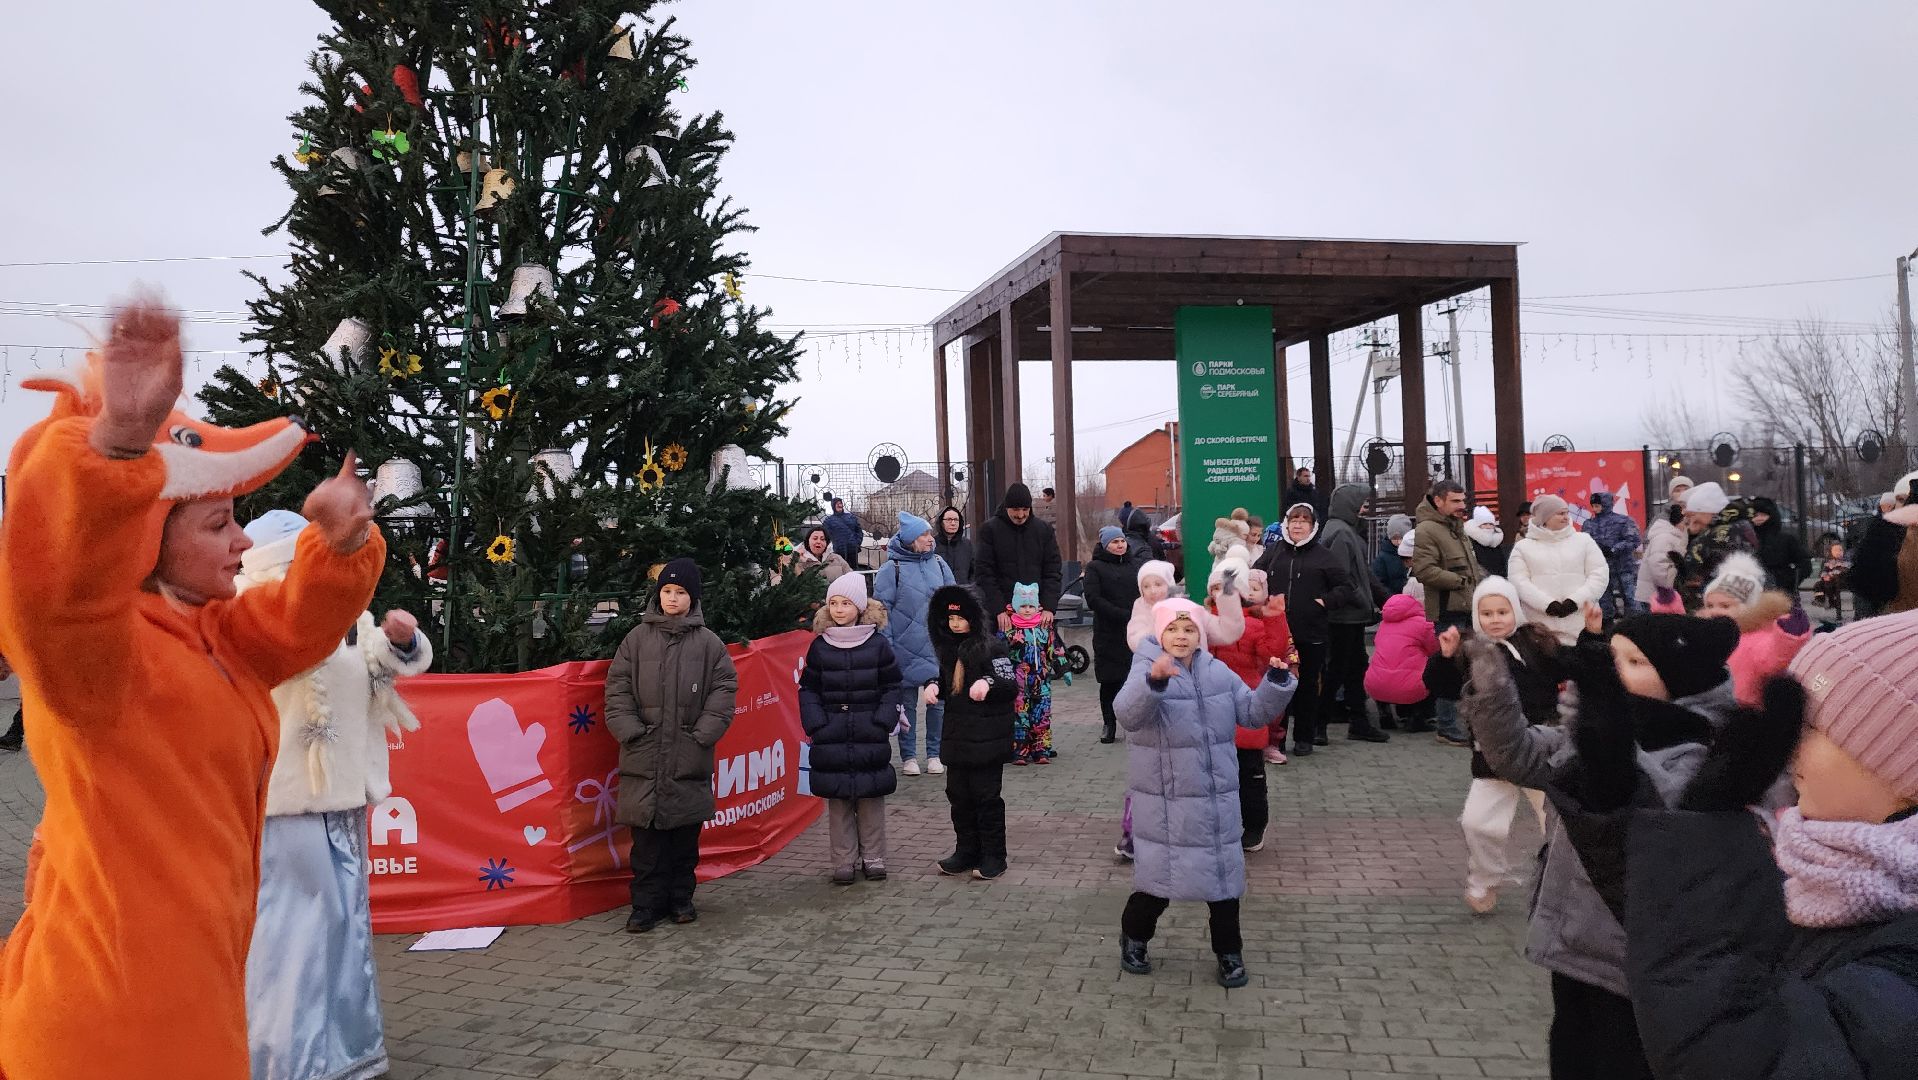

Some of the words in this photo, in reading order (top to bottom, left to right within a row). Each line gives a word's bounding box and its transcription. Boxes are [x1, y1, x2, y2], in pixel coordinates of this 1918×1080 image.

[1208, 360, 1234, 368] ПАРКИ
[1208, 367, 1266, 376] ПОДМОСКОВЬЯ
[1216, 383, 1236, 391] ПАРК
[1217, 388, 1259, 398] СЕРЕБРЯНЫЙ
[1194, 437, 1206, 445] ДО
[1206, 435, 1235, 444] СКОРОЙ
[1216, 458, 1244, 467] ВСЕГДА
[1244, 457, 1261, 465] ВАМ
[1207, 467, 1228, 475] РАДЫ
[1234, 466, 1257, 474] ПАРКЕ
[711, 738, 786, 799] ИМА
